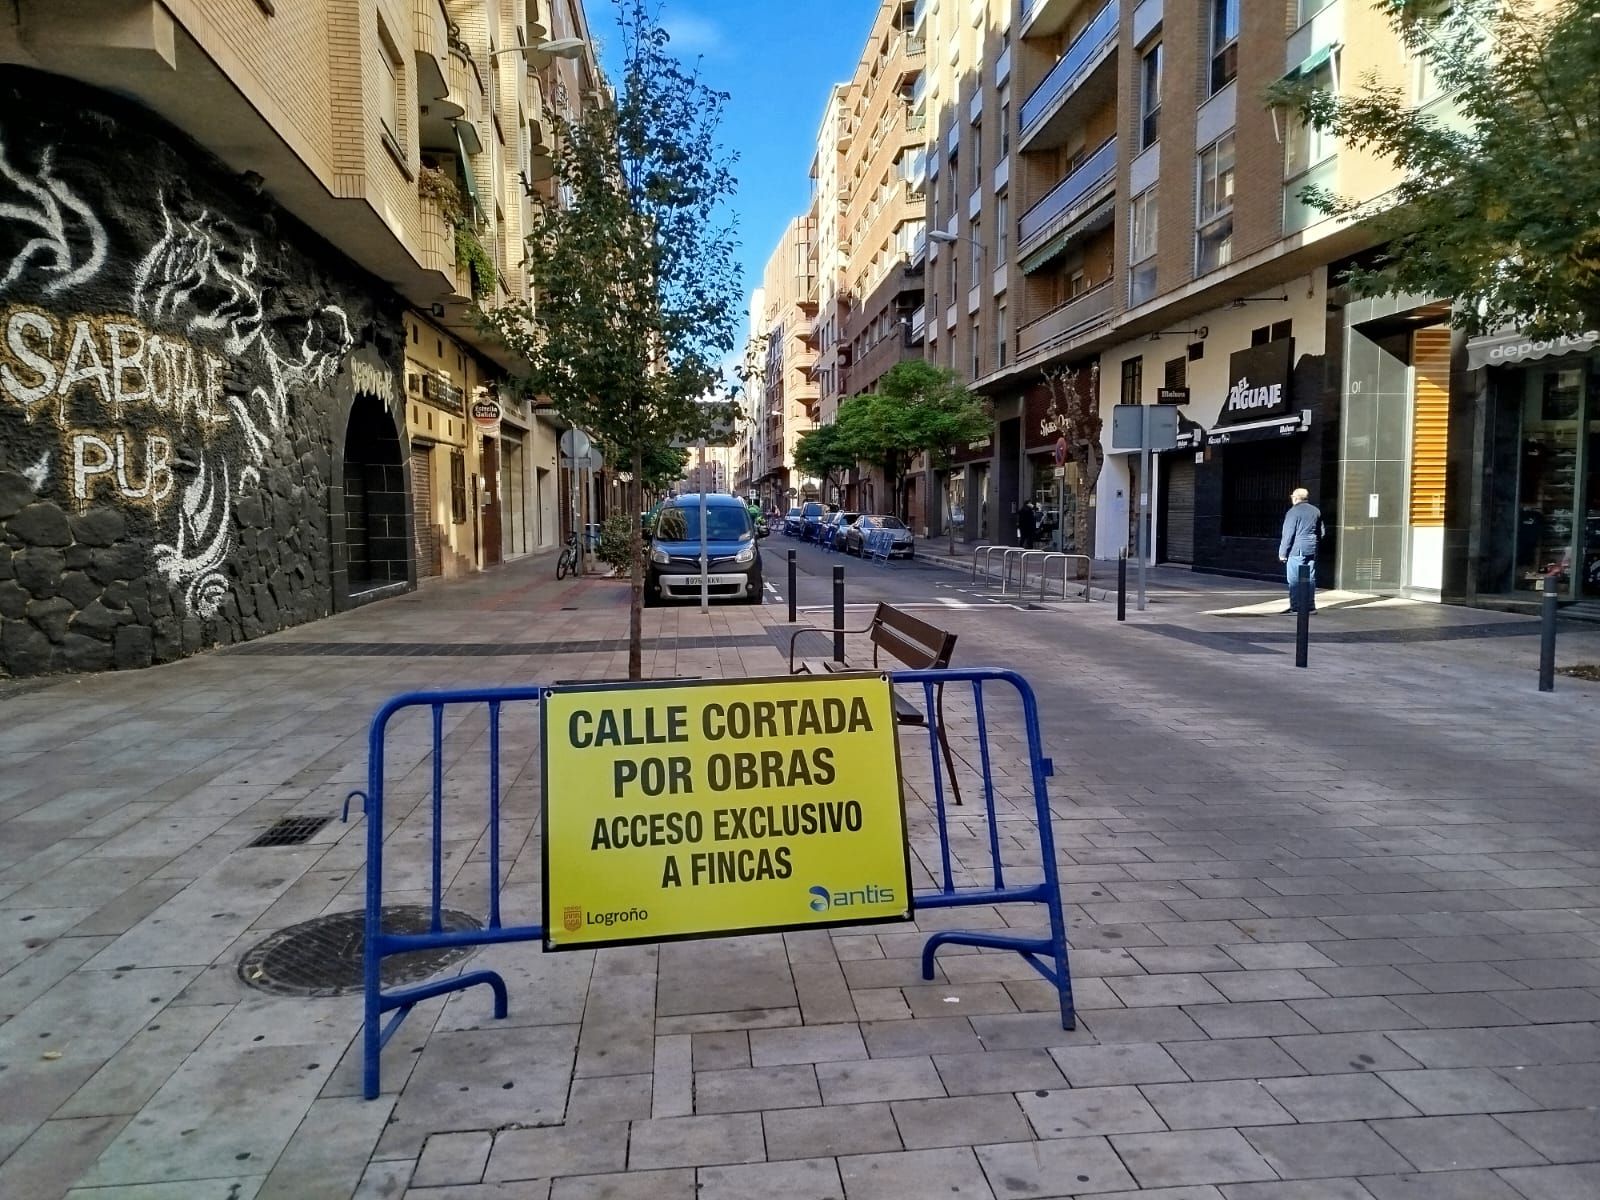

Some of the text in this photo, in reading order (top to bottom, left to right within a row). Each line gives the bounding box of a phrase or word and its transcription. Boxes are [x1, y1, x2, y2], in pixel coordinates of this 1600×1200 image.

[1228, 384, 1281, 411] AGUAJE
[1238, 376, 1249, 392] EL
[73, 433, 174, 501] PUB
[568, 697, 873, 749] CALLE CORTADA
[613, 747, 836, 798] POR OBRAS
[590, 800, 863, 850] ACCESO EXCLUSIVO
[661, 846, 793, 888] A FINCAS
[833, 884, 895, 906] antis
[586, 907, 648, 926] Logroño
